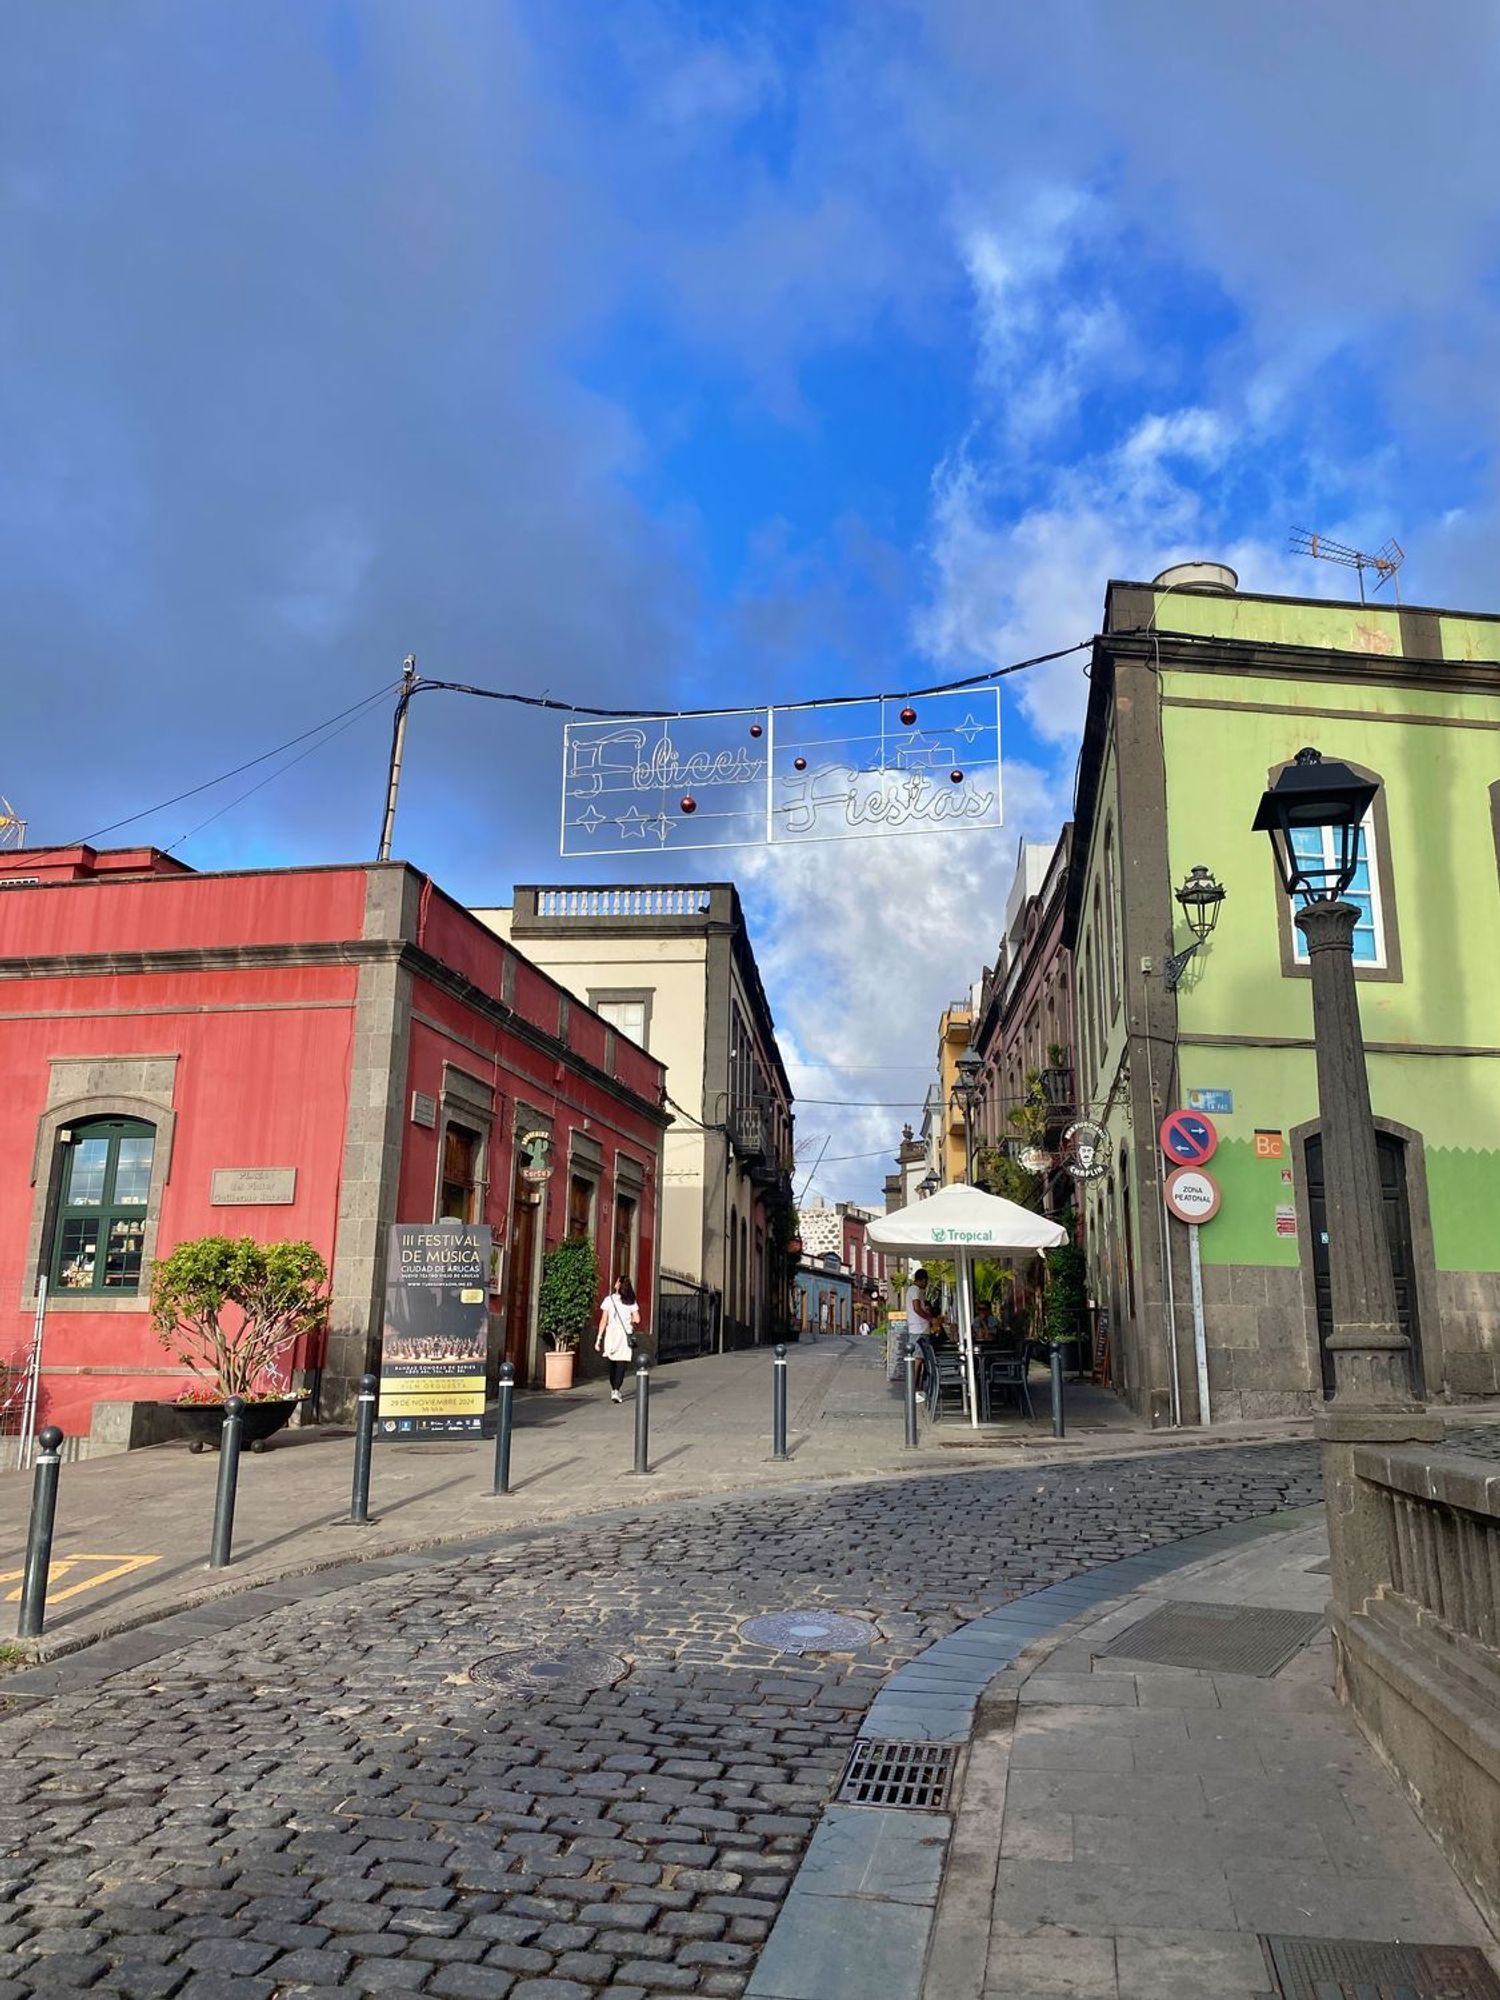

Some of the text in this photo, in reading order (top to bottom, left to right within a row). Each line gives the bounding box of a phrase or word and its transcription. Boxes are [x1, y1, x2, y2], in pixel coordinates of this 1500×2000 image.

[571, 727, 763, 799] Felices
[782, 762, 994, 833] Fiestas
[1257, 1136, 1281, 1155] Bc
[1069, 1165, 1104, 1178] CHAPLIN
[1182, 1185, 1203, 1194] ZONA
[1174, 1193, 1212, 1203] PEATONAL
[402, 1234, 480, 1247] III FESTIVAL
[946, 1228, 993, 1243] Tropical
[401, 1248, 480, 1263] DE MÚSICA
[401, 1265, 434, 1273] CIUDAD
[434, 1265, 446, 1273] DE
